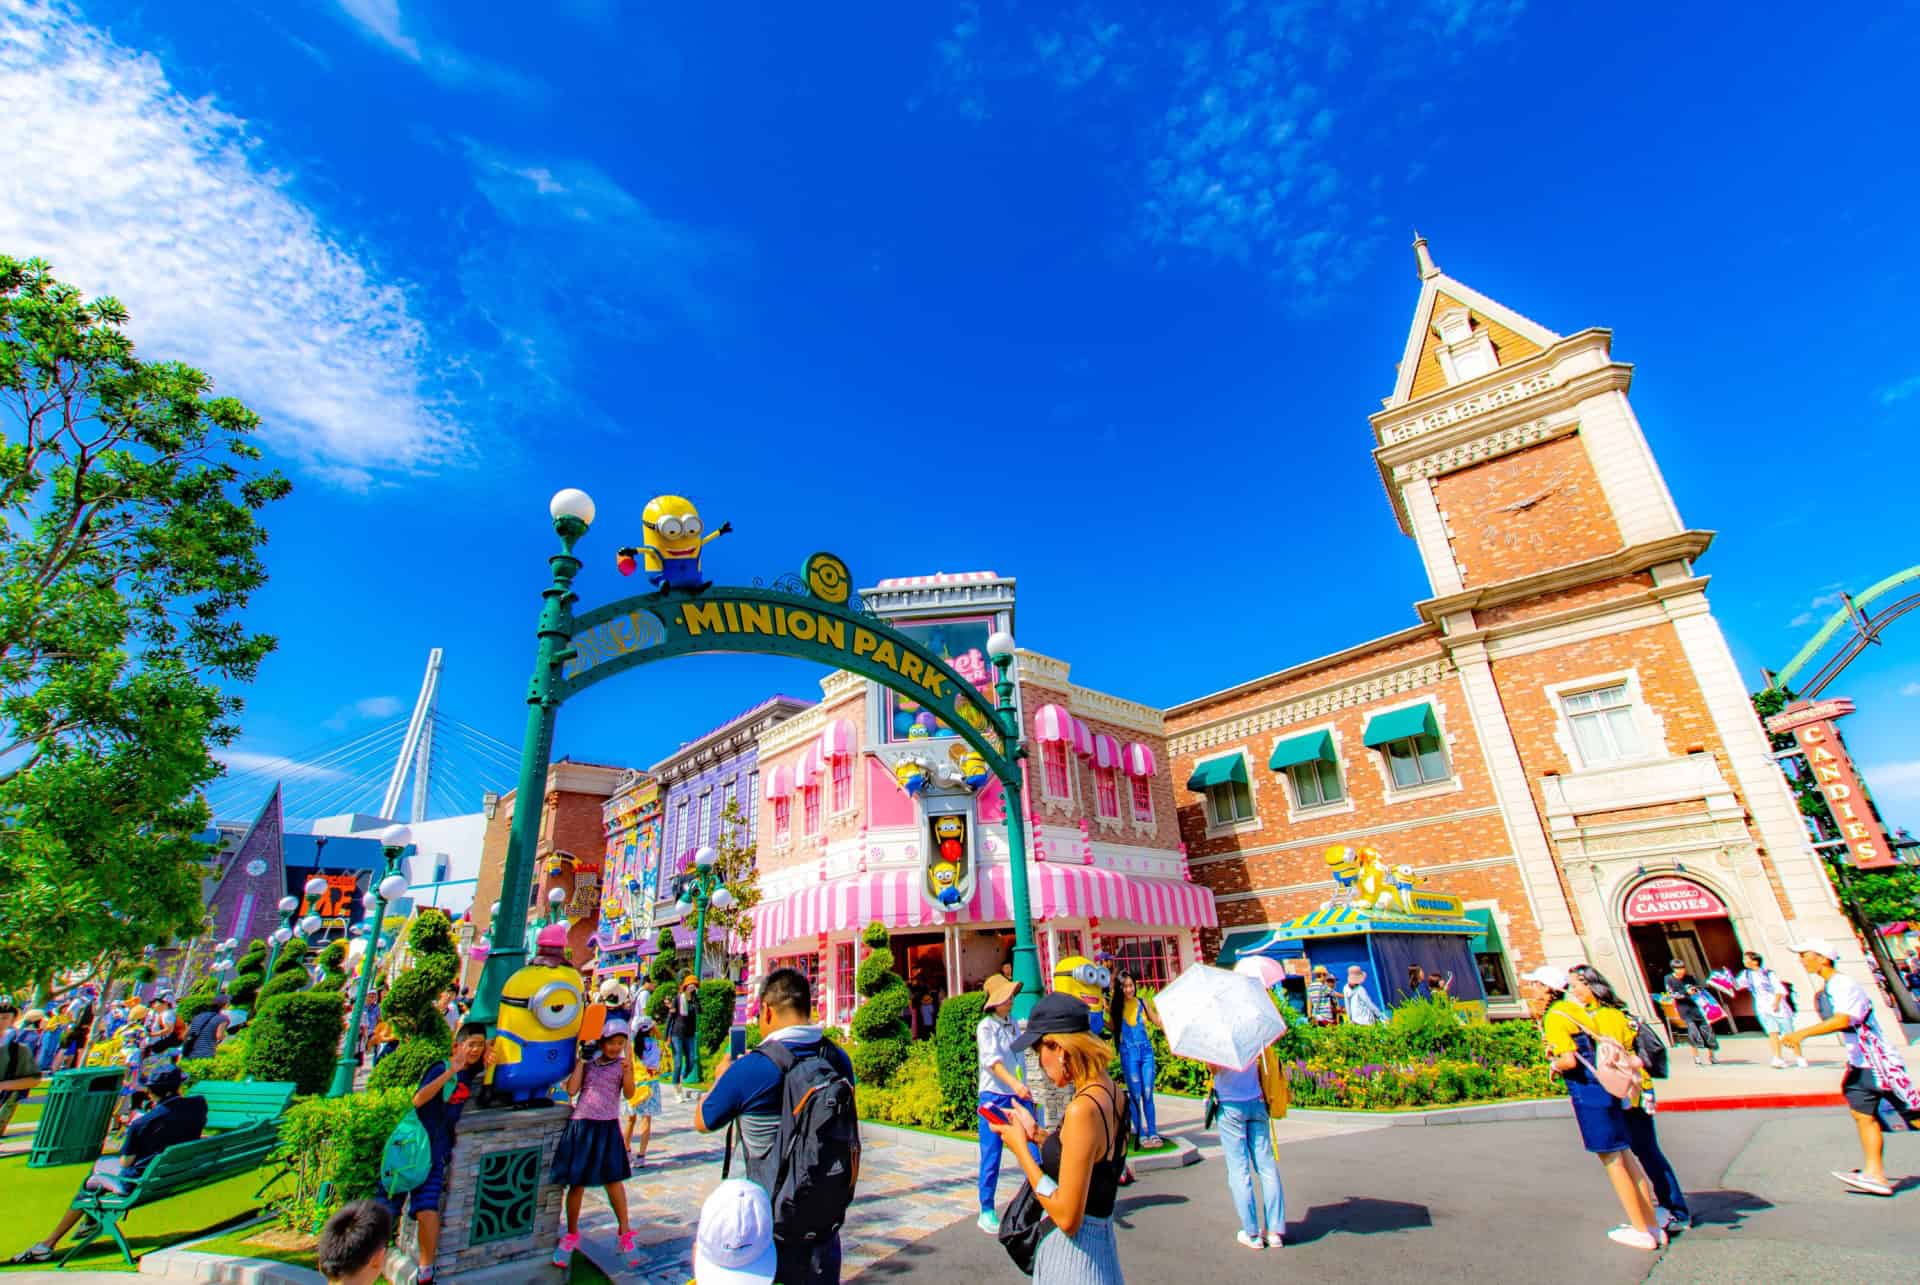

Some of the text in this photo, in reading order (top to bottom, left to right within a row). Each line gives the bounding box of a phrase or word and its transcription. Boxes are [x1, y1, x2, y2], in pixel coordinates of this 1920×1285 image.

[680, 602, 947, 697] MINION PARK
[1802, 726, 1878, 861] CANDIES
[1635, 898, 1709, 914] CANDIES
